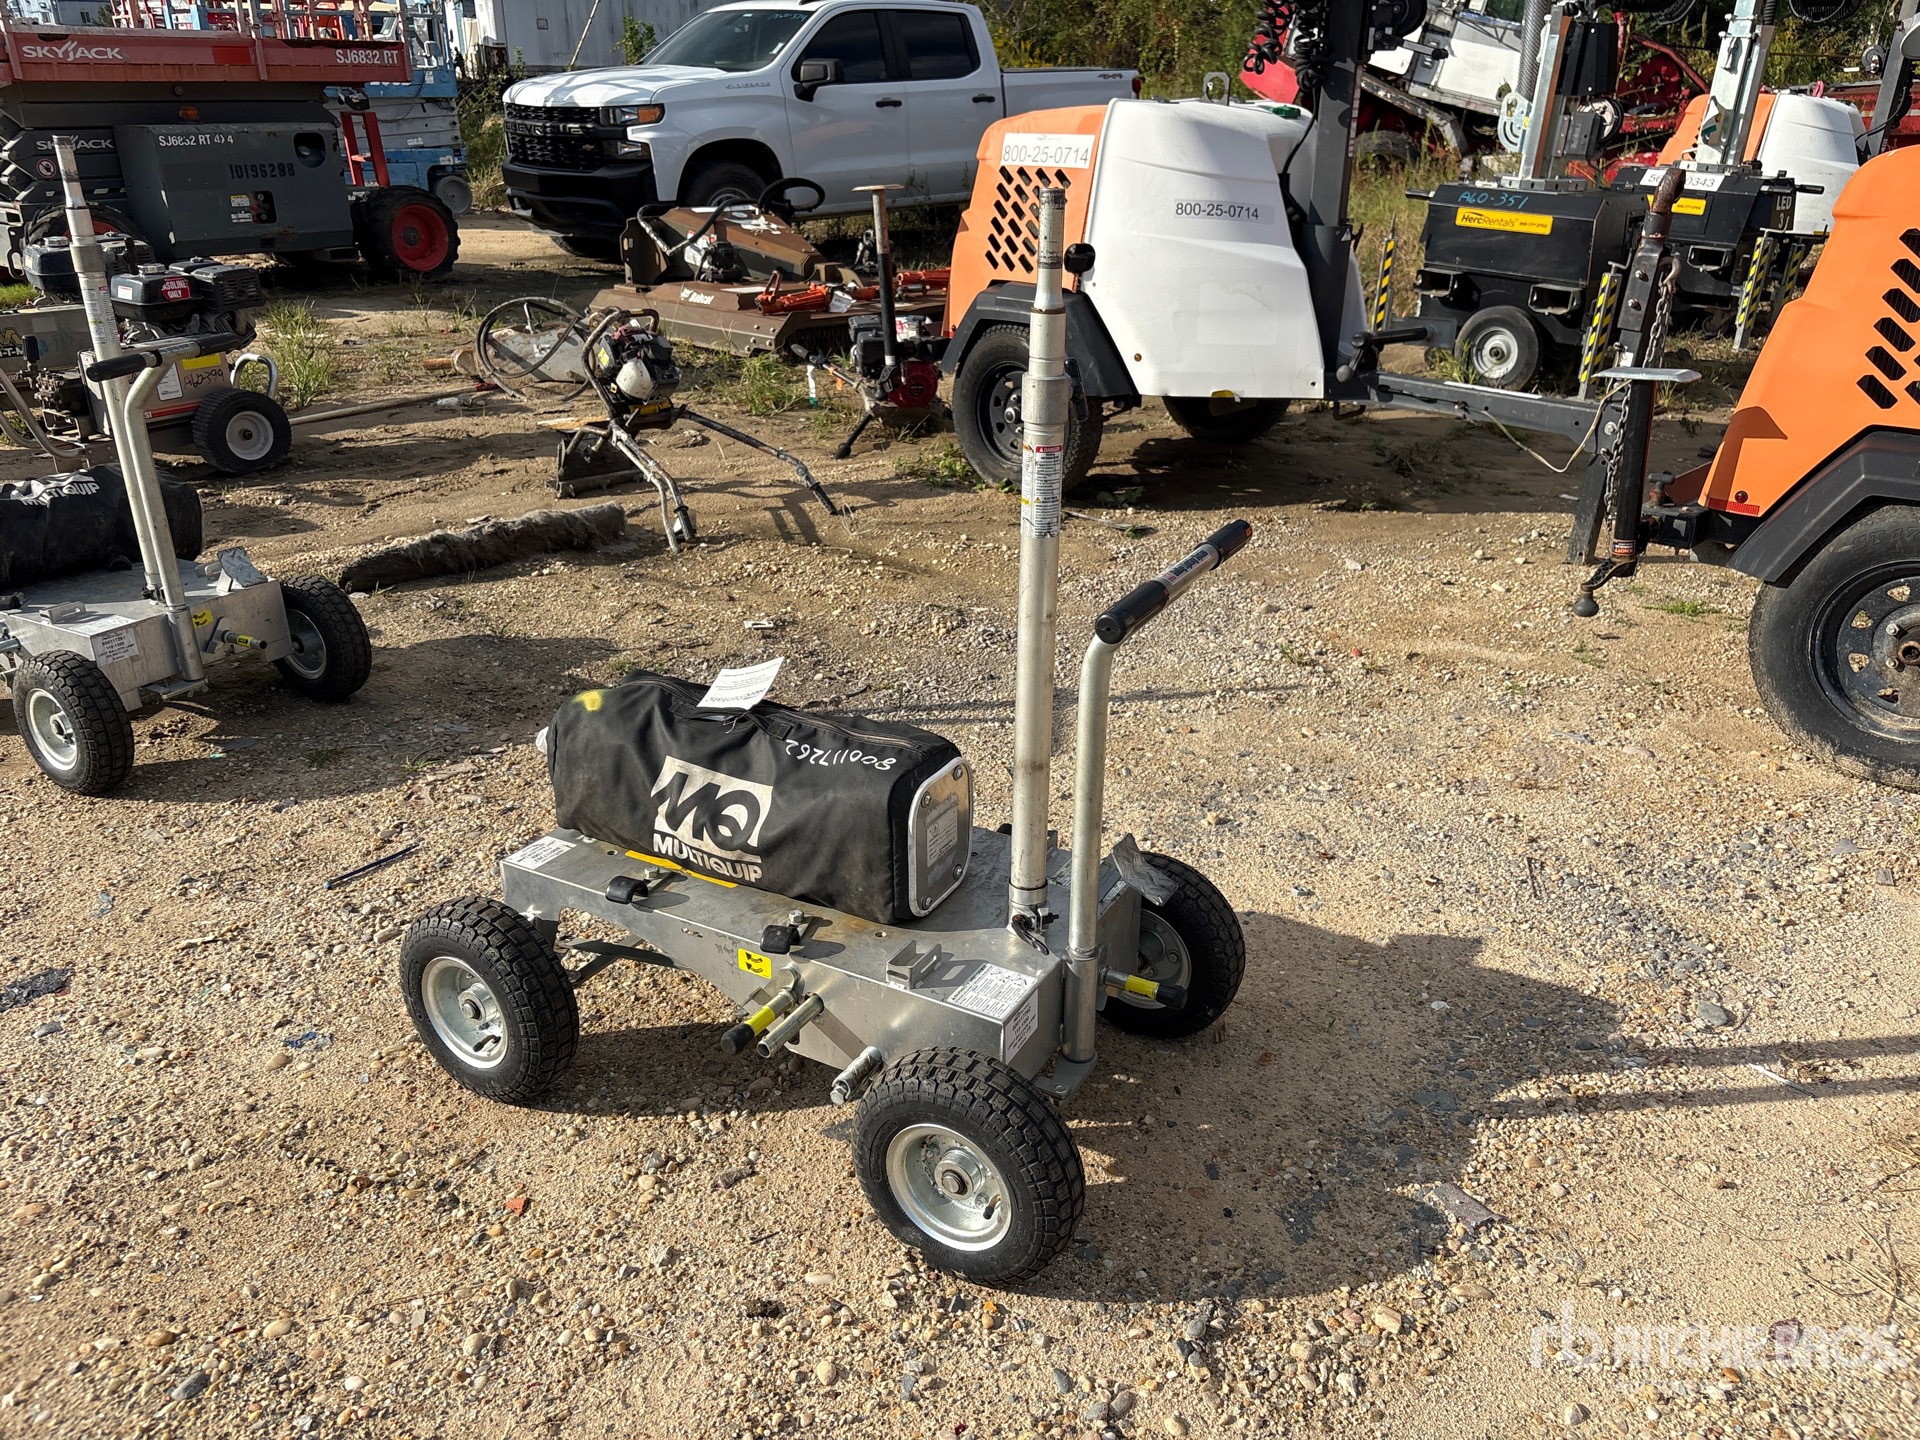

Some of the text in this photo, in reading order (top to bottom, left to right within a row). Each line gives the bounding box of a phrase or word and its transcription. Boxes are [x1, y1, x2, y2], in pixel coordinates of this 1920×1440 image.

[22, 40, 124, 62] SKYJACK
[336, 49, 398, 64] SJ6832 RT
[198, 134, 211, 146] RT
[1003, 145, 1089, 165] 800-25-0714
[229, 163, 296, 180] 10196288
[1457, 190, 1529, 209] A60-351
[1776, 195, 1792, 211] LED
[1175, 202, 1259, 220] 800-25-0714
[785, 739, 896, 771] 800117262
[651, 771, 761, 854] MQ
[653, 833, 763, 883] MULTIQUIP
